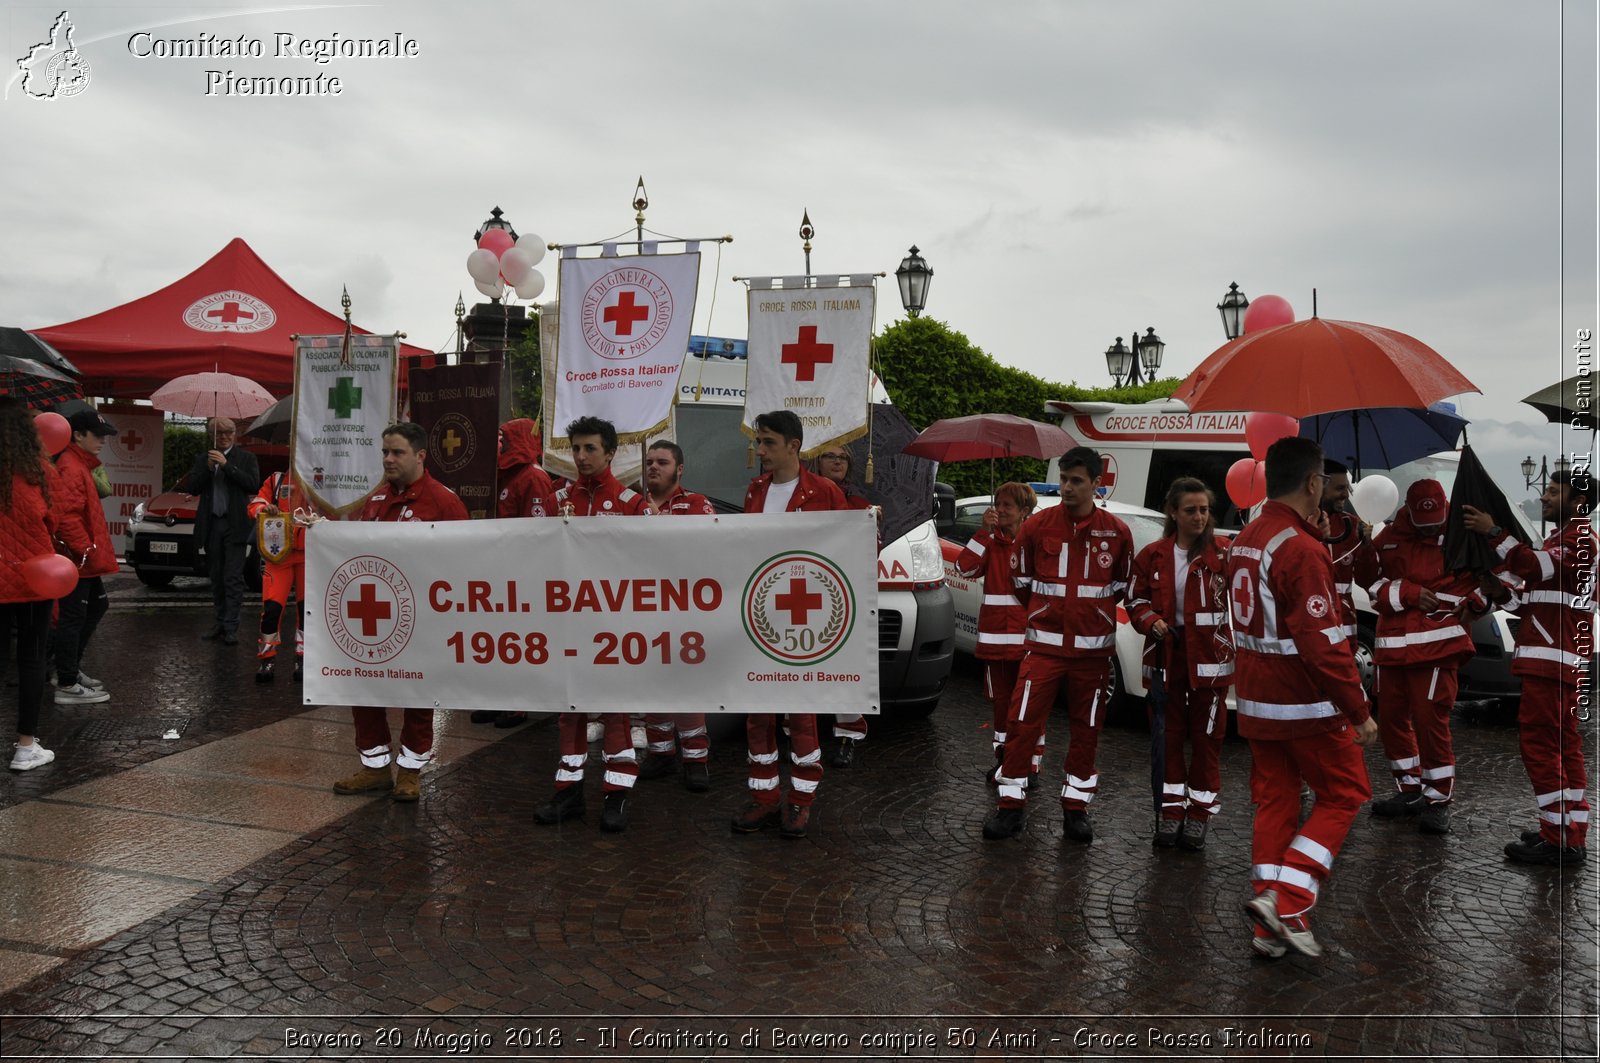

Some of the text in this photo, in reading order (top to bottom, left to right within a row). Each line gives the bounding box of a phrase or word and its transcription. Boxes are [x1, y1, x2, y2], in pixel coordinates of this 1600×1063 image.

[582, 270, 671, 356] CONVENZIONE DI GINEVRA 22 AGOSTO 1864
[759, 299, 861, 312] CROCE ROSSA ITALIANA
[306, 351, 341, 360] ASSOCIAZI
[565, 370, 598, 382] Croce
[600, 366, 635, 379] Rossa
[438, 388, 461, 401] ROSSA
[465, 386, 497, 399] ITALIANA
[581, 379, 663, 394] Comitato di Baveno
[784, 397, 825, 408] COMITATO
[342, 424, 365, 433] VERDE
[1106, 416, 1148, 430] CROCE
[1149, 415, 1193, 430] ROSSA
[355, 437, 374, 446] TOCE
[325, 474, 369, 483] PROVINCIA
[109, 483, 152, 498] IUTACI
[428, 578, 723, 613] C.R.I. BAVENO
[328, 560, 410, 658] CONVENZIONE DI GINEVRA 22 AGOSTO 1864
[783, 627, 815, 652] 50
[446, 631, 707, 665] 1968 - 2018
[321, 666, 424, 680] Croce Rossa Italiana
[747, 671, 861, 683] Comitato di Baveno
